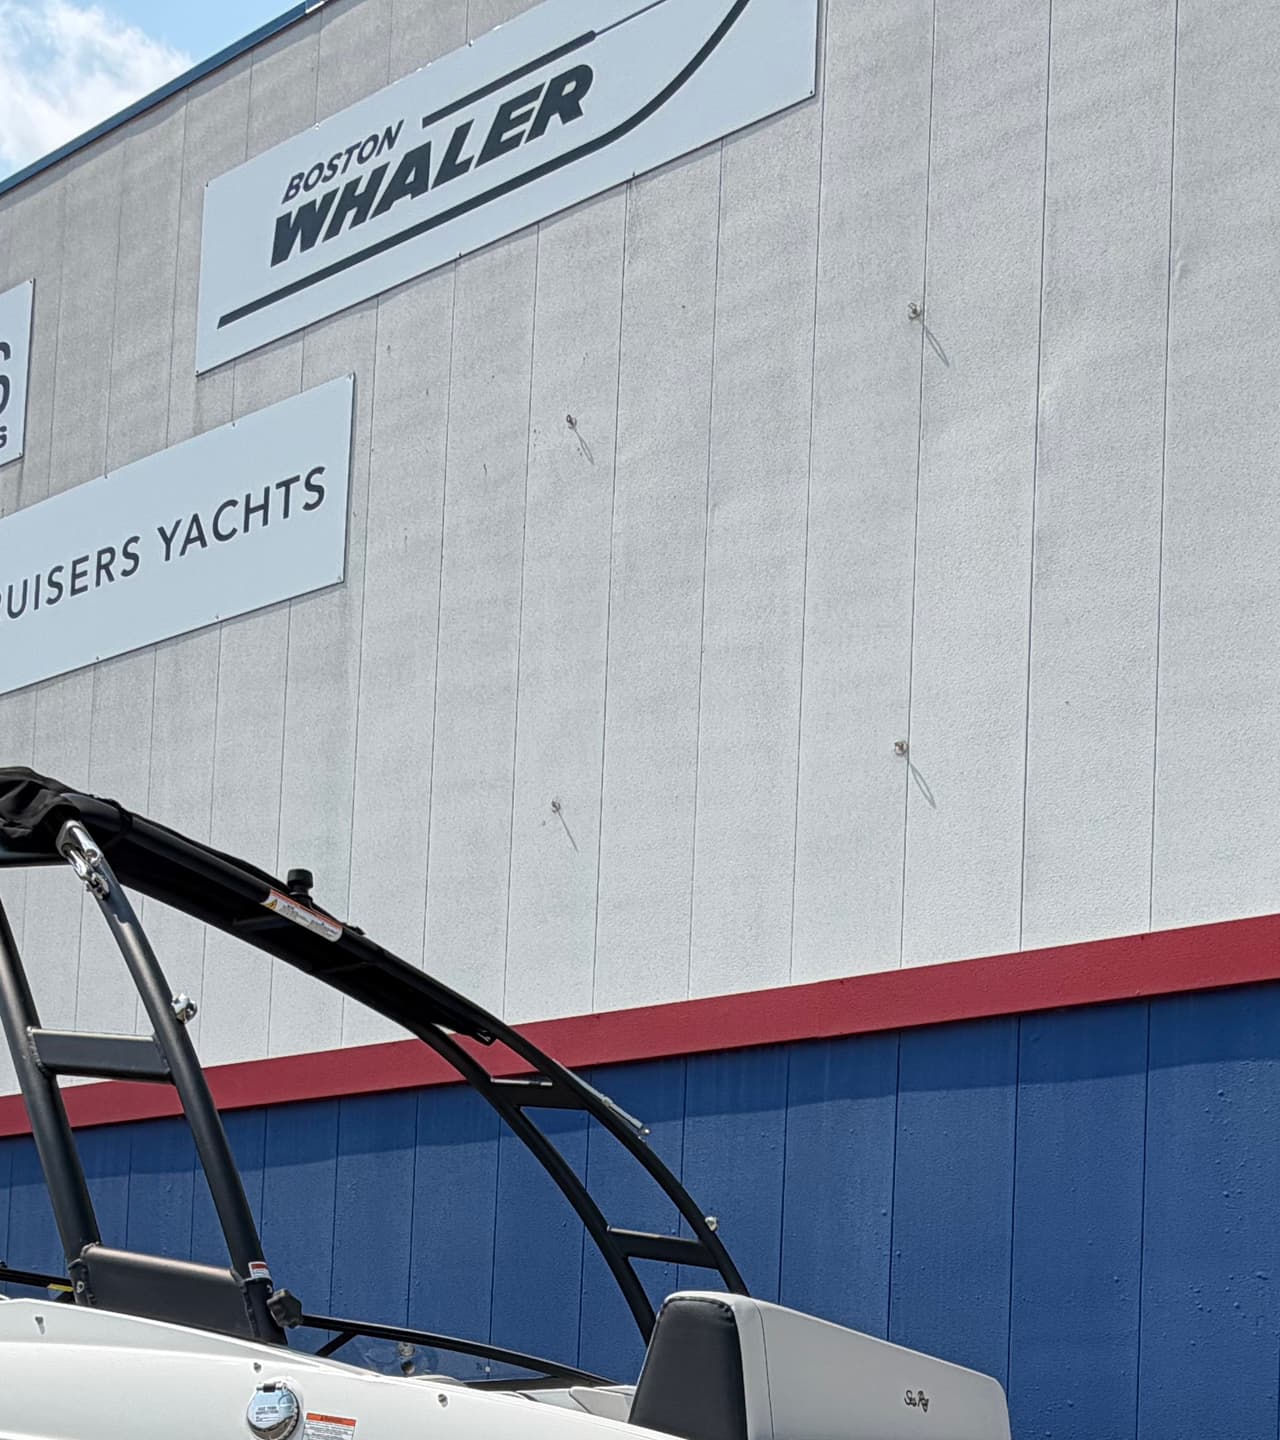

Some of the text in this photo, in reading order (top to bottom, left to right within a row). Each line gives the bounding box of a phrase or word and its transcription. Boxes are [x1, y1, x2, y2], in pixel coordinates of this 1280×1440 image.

[270, 64, 595, 268] WHALER
[281, 119, 404, 204] BOSTON
[157, 466, 326, 562] YACHTS
